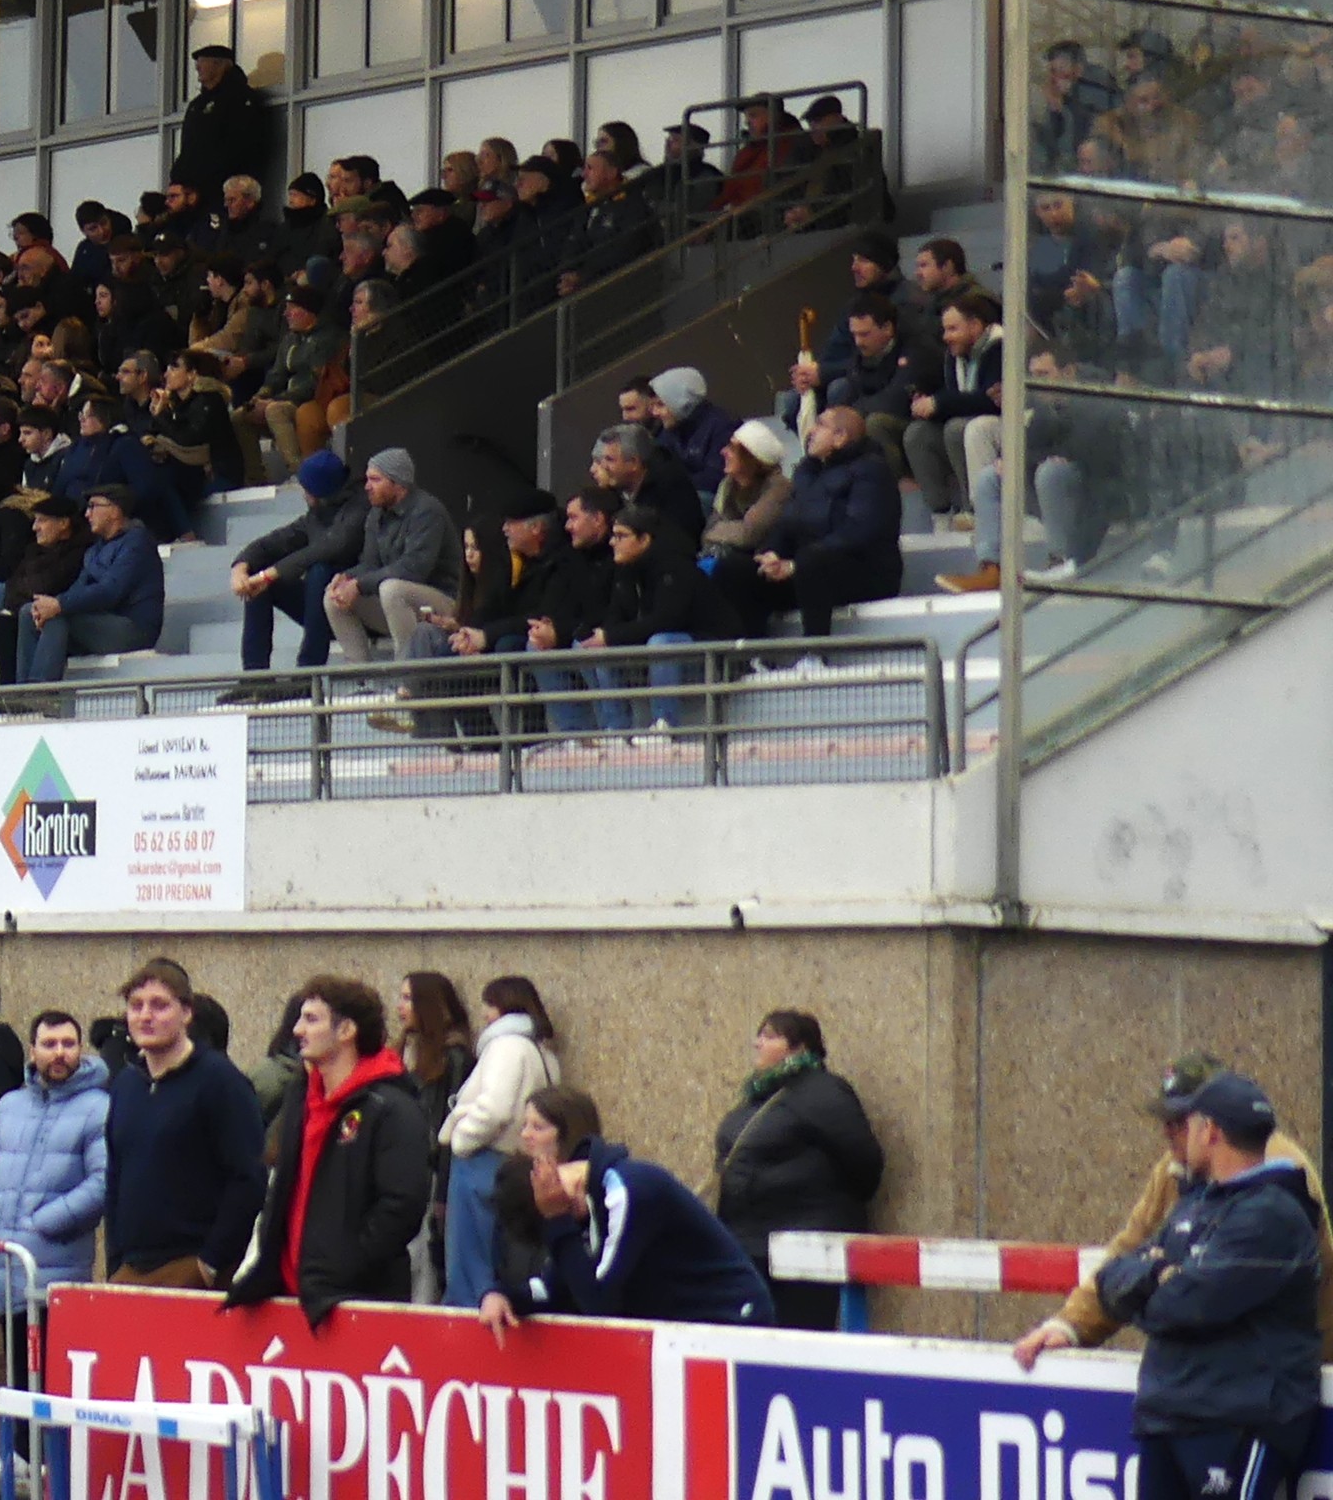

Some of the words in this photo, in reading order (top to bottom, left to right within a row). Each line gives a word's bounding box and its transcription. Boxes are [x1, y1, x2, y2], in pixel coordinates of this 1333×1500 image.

[24, 801, 90, 857] Karotec
[134, 831, 147, 851] 05
[150, 831, 164, 851] 62
[167, 831, 181, 851] 65
[184, 830, 198, 851] 68
[201, 830, 216, 850] 07
[165, 883, 213, 901] PREIGNAN
[752, 1392, 945, 1500] Auto
